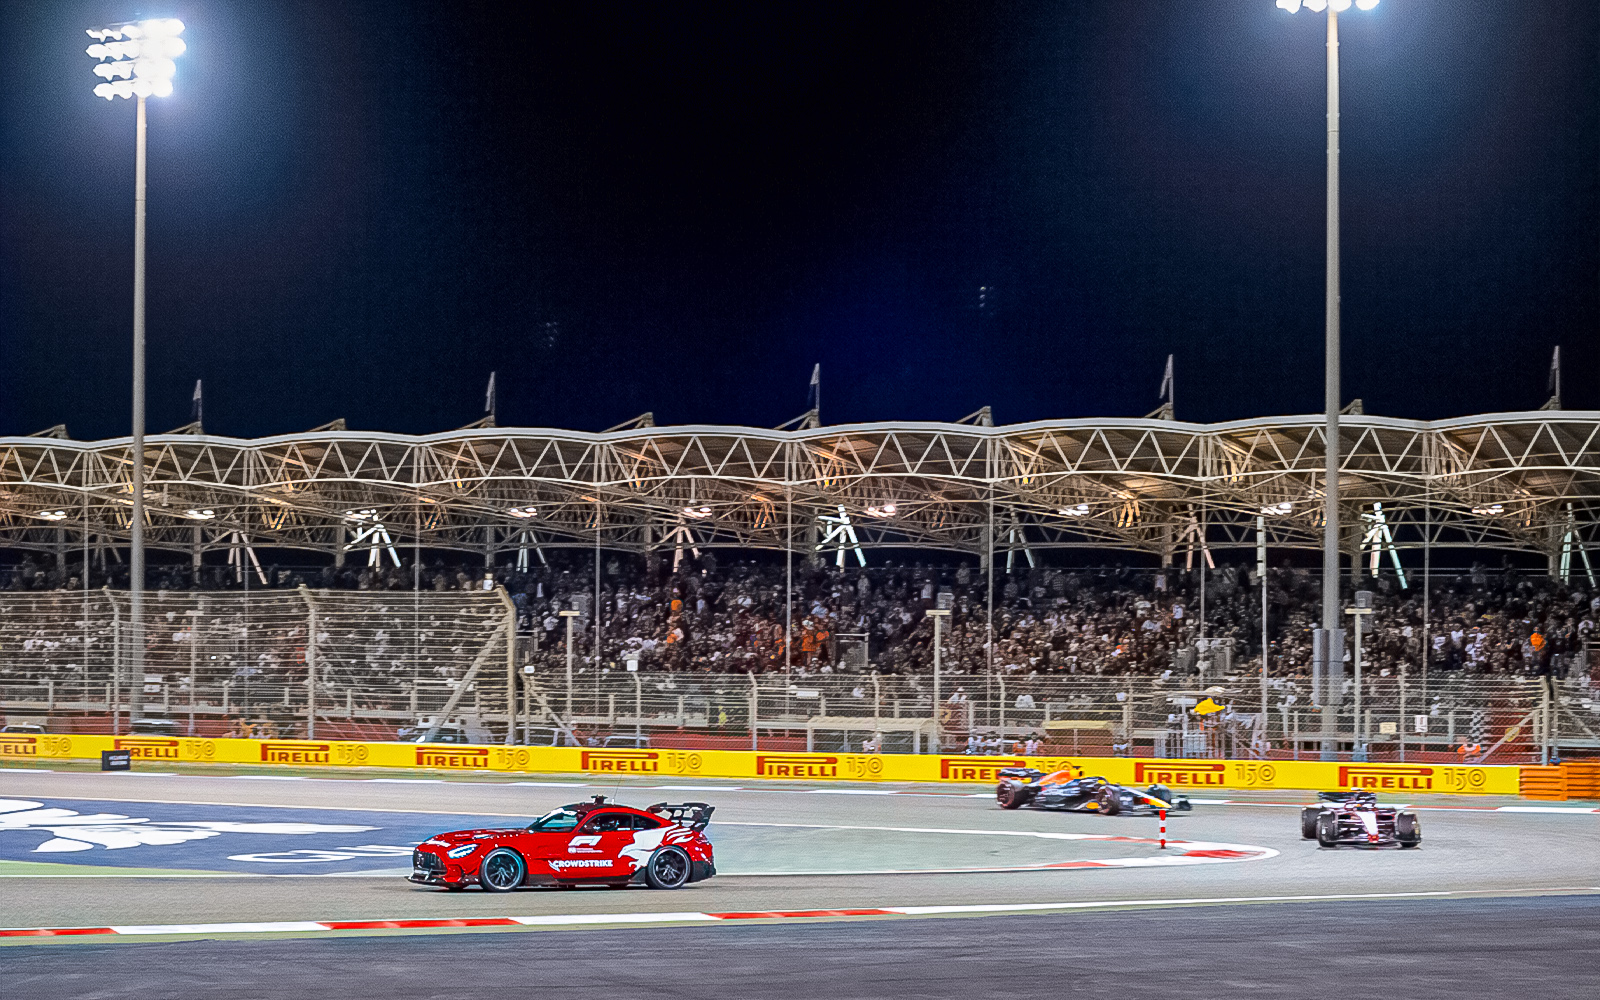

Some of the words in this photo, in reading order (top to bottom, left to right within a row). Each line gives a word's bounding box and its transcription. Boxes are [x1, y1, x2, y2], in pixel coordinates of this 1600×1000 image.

[43, 737, 73, 756] 150
[114, 738, 179, 758] PRELLI
[184, 739, 216, 759] 150
[261, 743, 330, 763] PIRELLI
[337, 744, 369, 764] 150
[416, 746, 489, 767] PIRELLI
[495, 748, 530, 768] 150
[581, 751, 659, 772] PIRELLI
[667, 752, 703, 773] 150
[757, 756, 838, 777] PIRELLI
[846, 757, 884, 778] 150
[1135, 762, 1225, 785] PIRELLI
[1235, 763, 1277, 786] 150
[1339, 766, 1434, 790] PIRELLI
[1443, 767, 1487, 791] 150
[552, 859, 614, 868] CROWDSTRIKE
